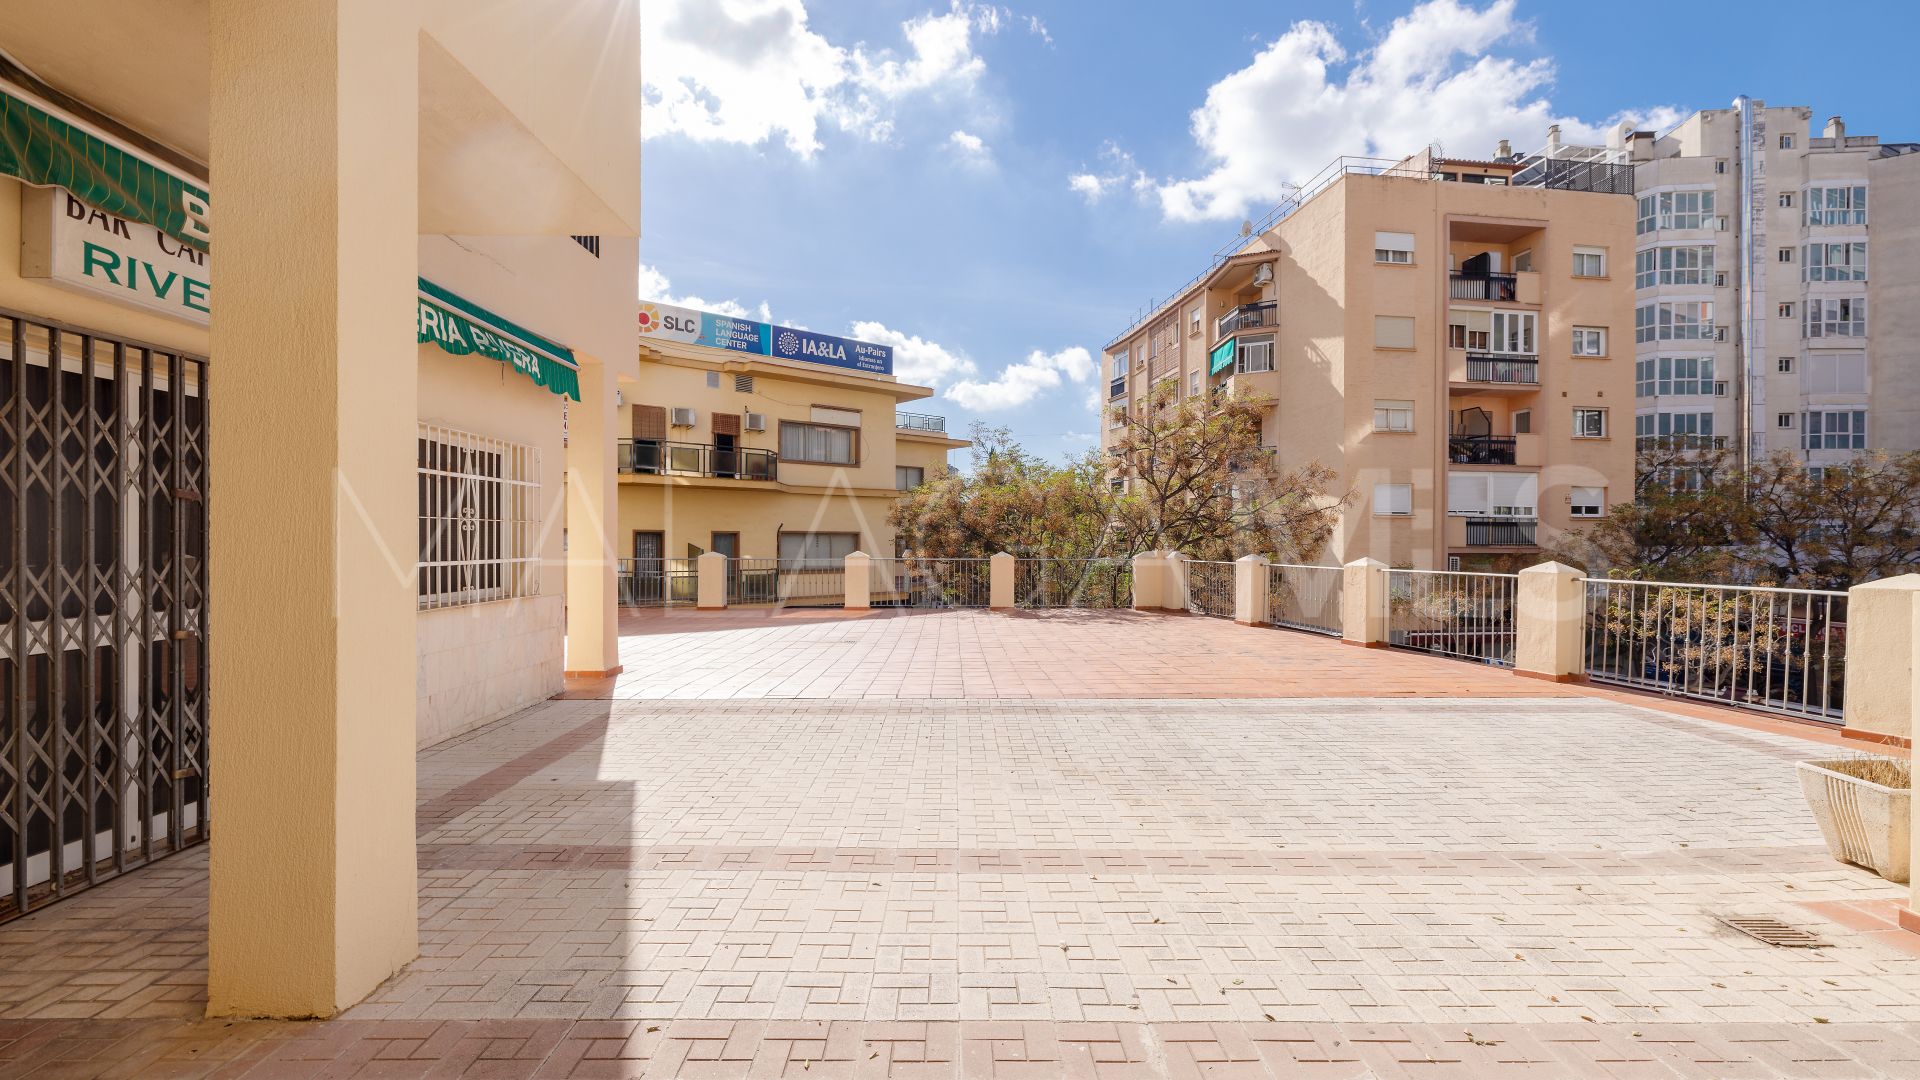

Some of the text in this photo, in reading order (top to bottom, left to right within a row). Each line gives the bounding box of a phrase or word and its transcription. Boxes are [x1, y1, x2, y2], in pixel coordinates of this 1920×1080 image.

[82, 240, 210, 313] RIVE
[418, 303, 468, 348] RIA
[663, 315, 695, 334] SLC
[715, 319, 751, 332] SPANISH
[715, 328, 759, 343] LANGUAGE
[715, 337, 747, 350] CENTER
[802, 338, 847, 361] IA&LA
